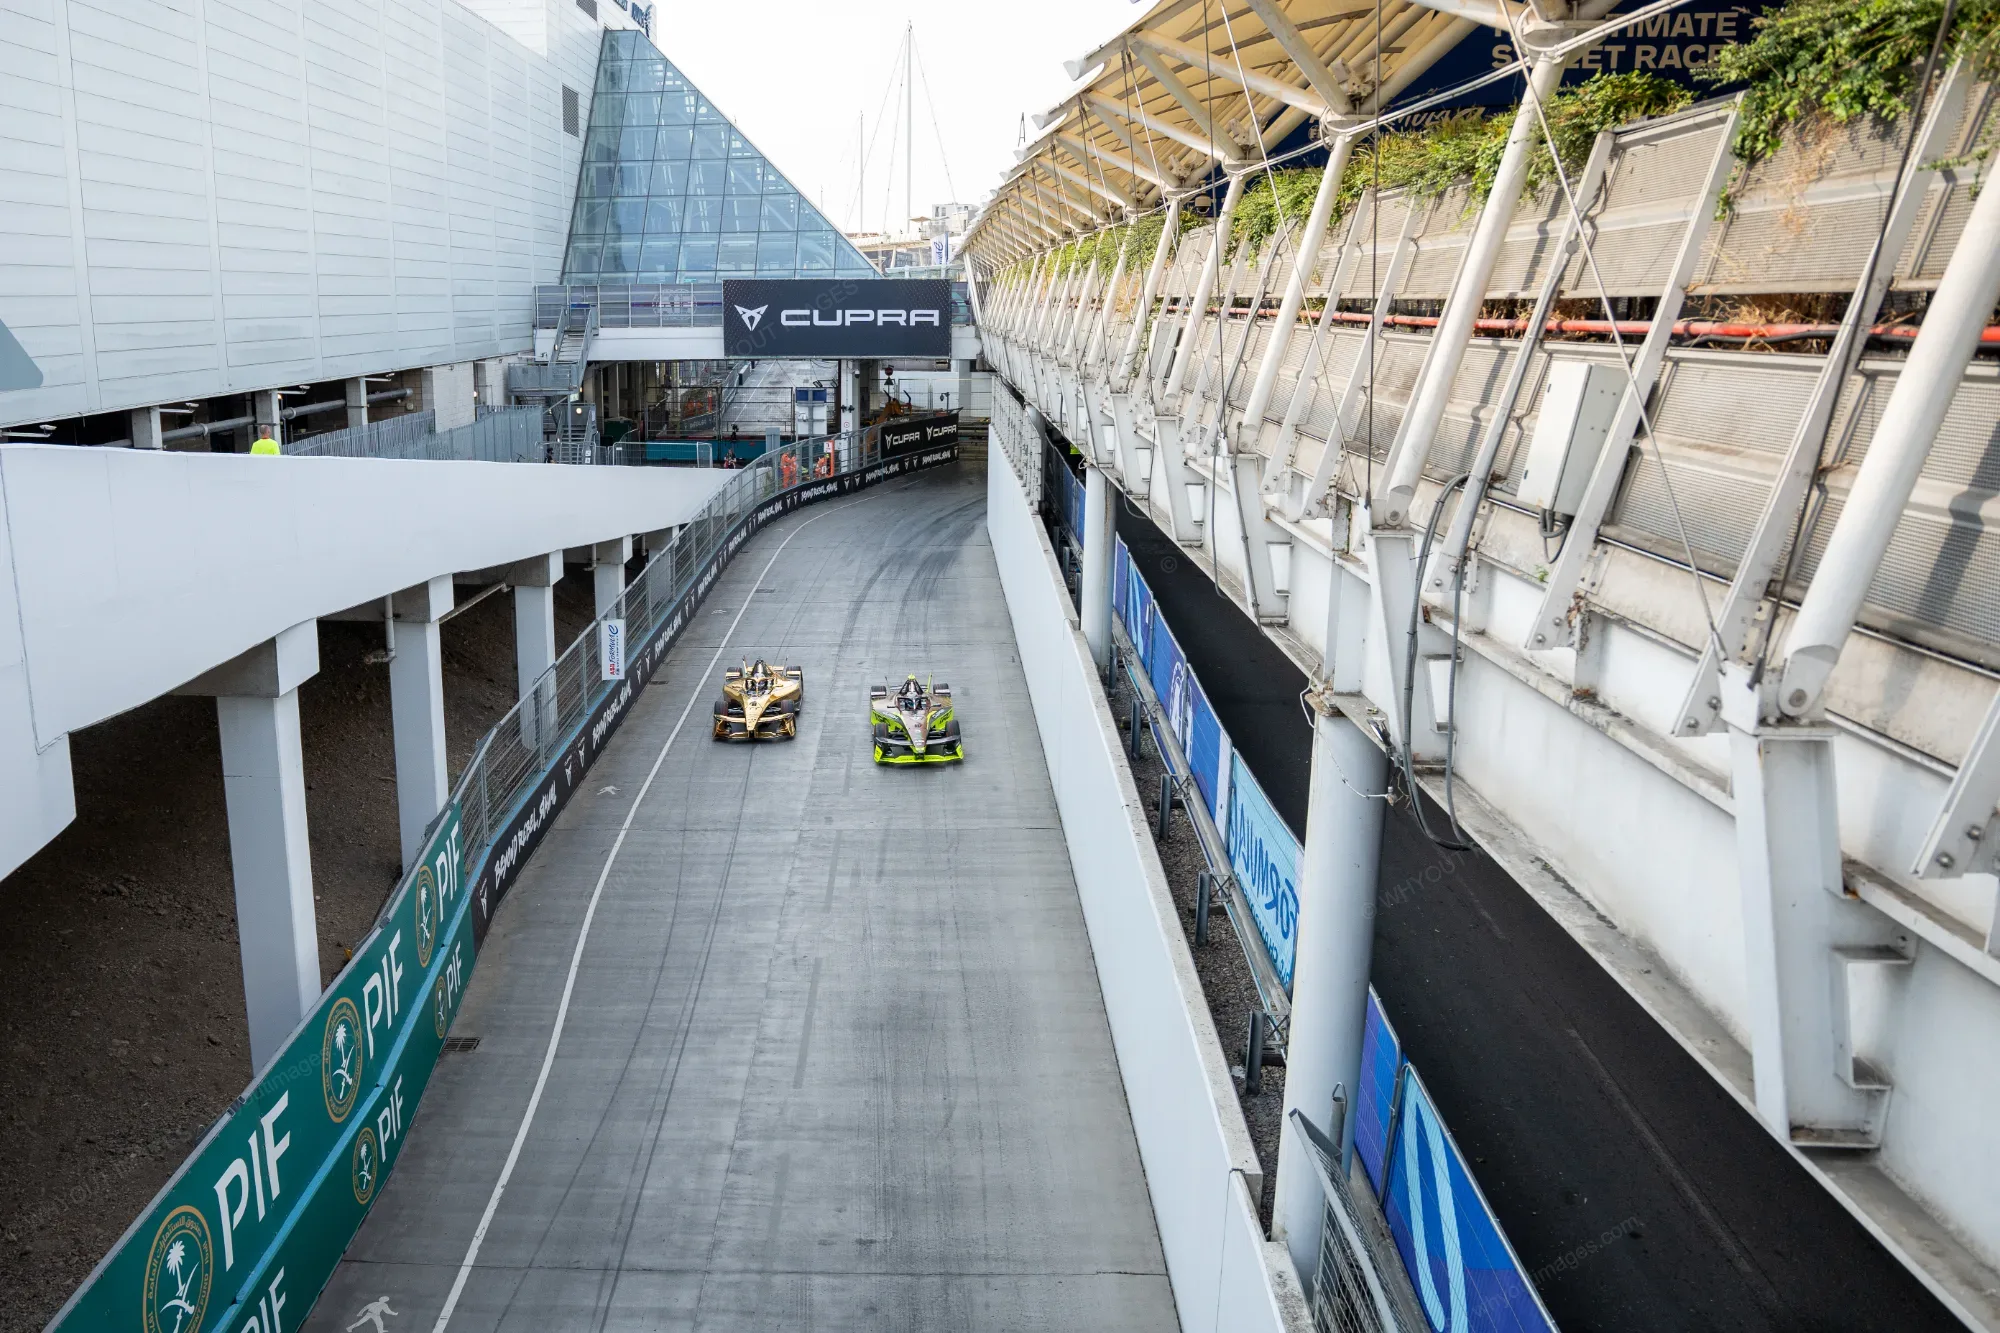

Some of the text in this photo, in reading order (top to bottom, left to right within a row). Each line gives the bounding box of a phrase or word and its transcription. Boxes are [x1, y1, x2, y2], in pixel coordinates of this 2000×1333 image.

[1606, 12, 1739, 38] TIMATE
[1491, 44, 1626, 69] SET
[780, 309, 940, 327] CUPRA
[892, 431, 920, 446] CUPRA
[932, 424, 957, 438] CUPRA
[435, 820, 461, 923] PIF
[362, 928, 403, 1060] PIF
[446, 941, 462, 1009] PIF
[377, 1074, 404, 1163] PIF
[213, 1089, 292, 1272] PIF
